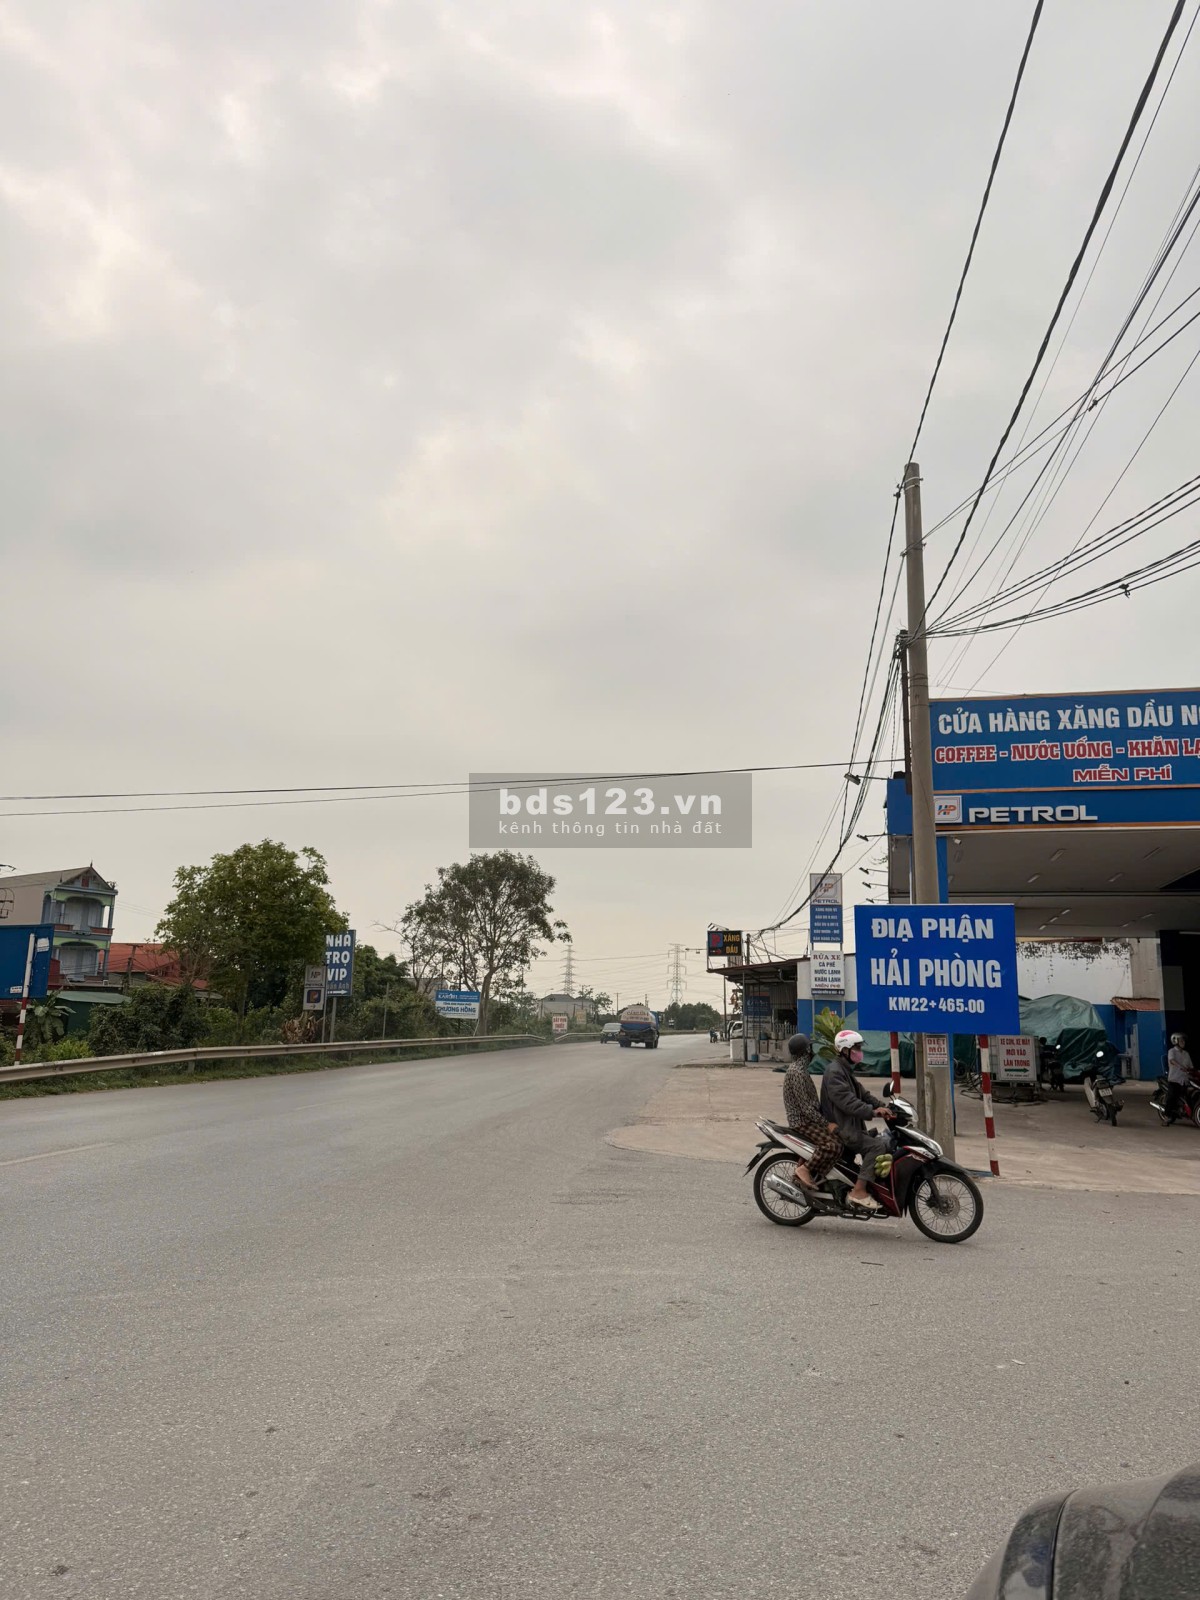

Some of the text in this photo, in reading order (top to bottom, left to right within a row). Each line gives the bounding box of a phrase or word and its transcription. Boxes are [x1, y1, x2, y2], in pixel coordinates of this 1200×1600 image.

[938, 699, 1200, 735] CỬA HÀNG XĂNG DẦU N
[935, 744, 997, 764] COFFEE
[1011, 739, 1061, 762] NƯỚC
[1062, 735, 1114, 760] UỐNG
[1127, 735, 1180, 758] KHĂN
[1073, 763, 1173, 782] MIỄN PHÍ
[968, 804, 1098, 823] PETROL
[921, 914, 994, 943] PHẬN
[325, 951, 351, 967] TRỌ
[813, 952, 830, 960] RỬA
[327, 968, 348, 981] VIP
[870, 948, 1002, 988] HẢI PHÒNG
[1014, 1059, 1030, 1067] TRONG
